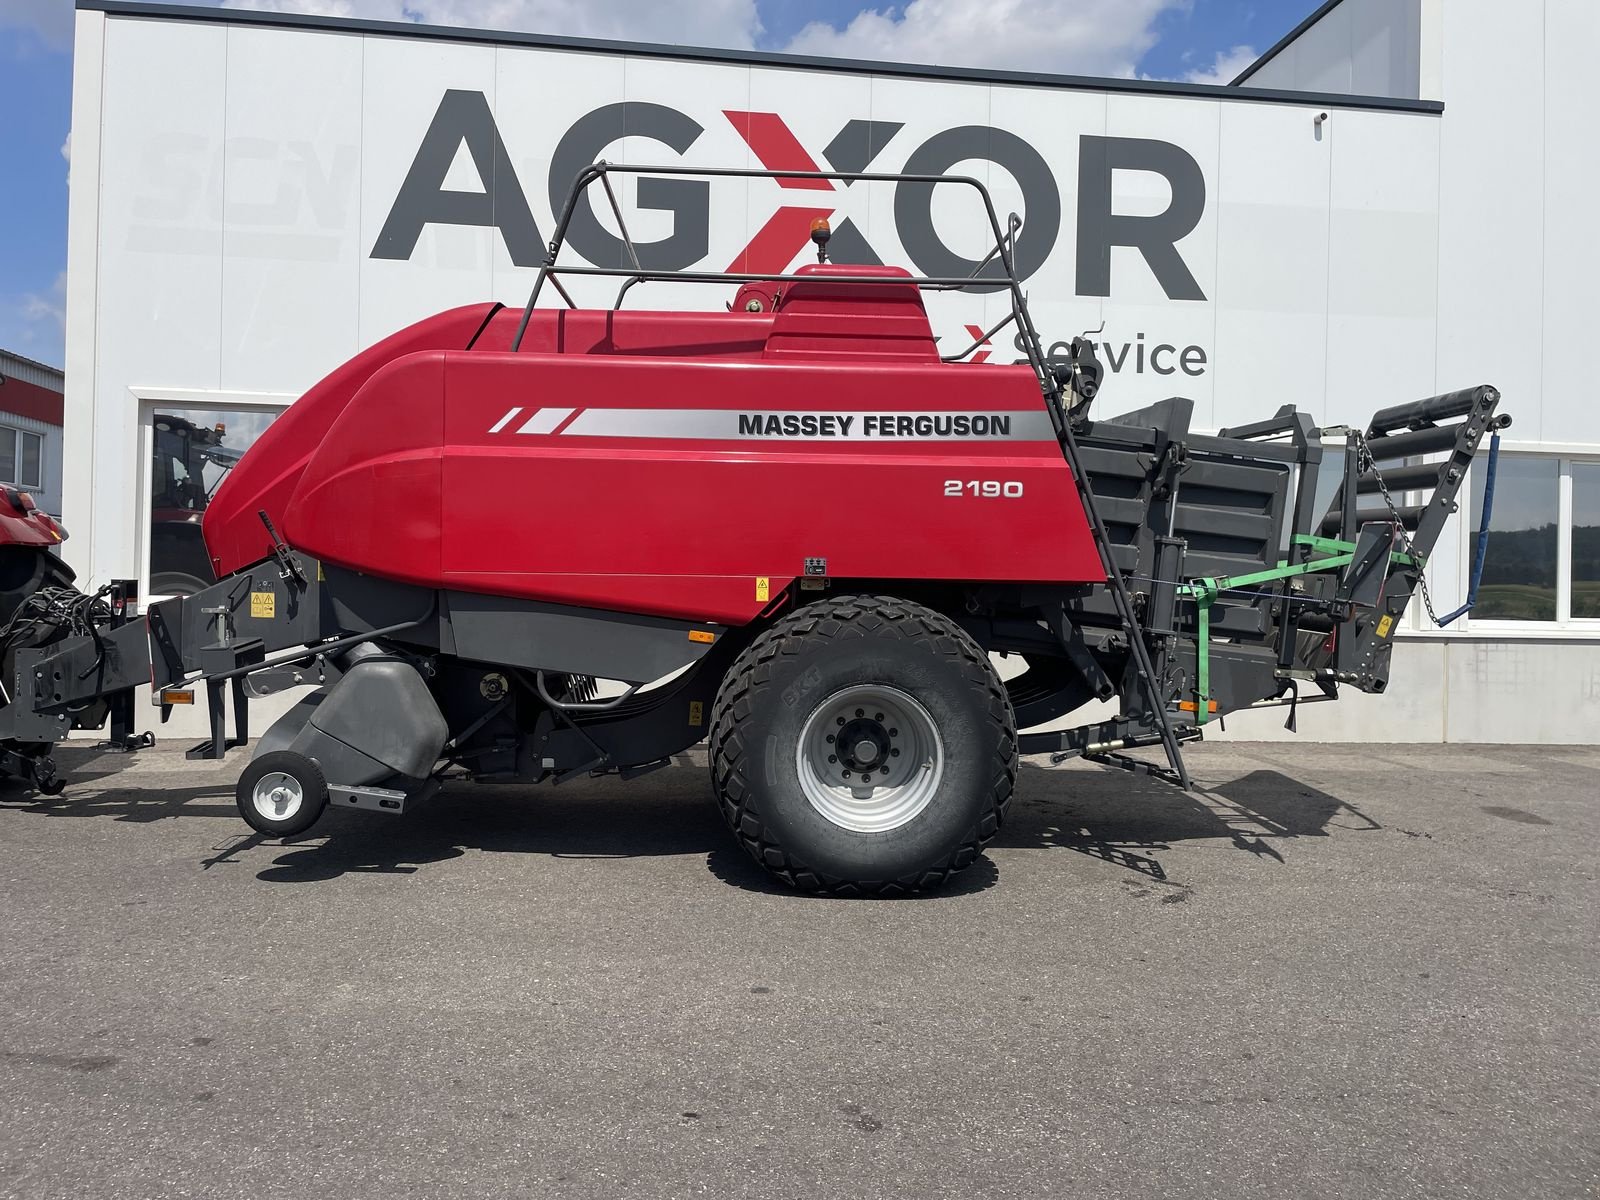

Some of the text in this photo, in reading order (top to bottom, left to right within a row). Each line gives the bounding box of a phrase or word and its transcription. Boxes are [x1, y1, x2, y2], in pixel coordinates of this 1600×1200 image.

[369, 88, 1208, 302] AGXOR
[1014, 329, 1207, 377] Sevice
[738, 414, 1010, 437] MASSEY FERGUSON
[943, 479, 1024, 498] 2190
